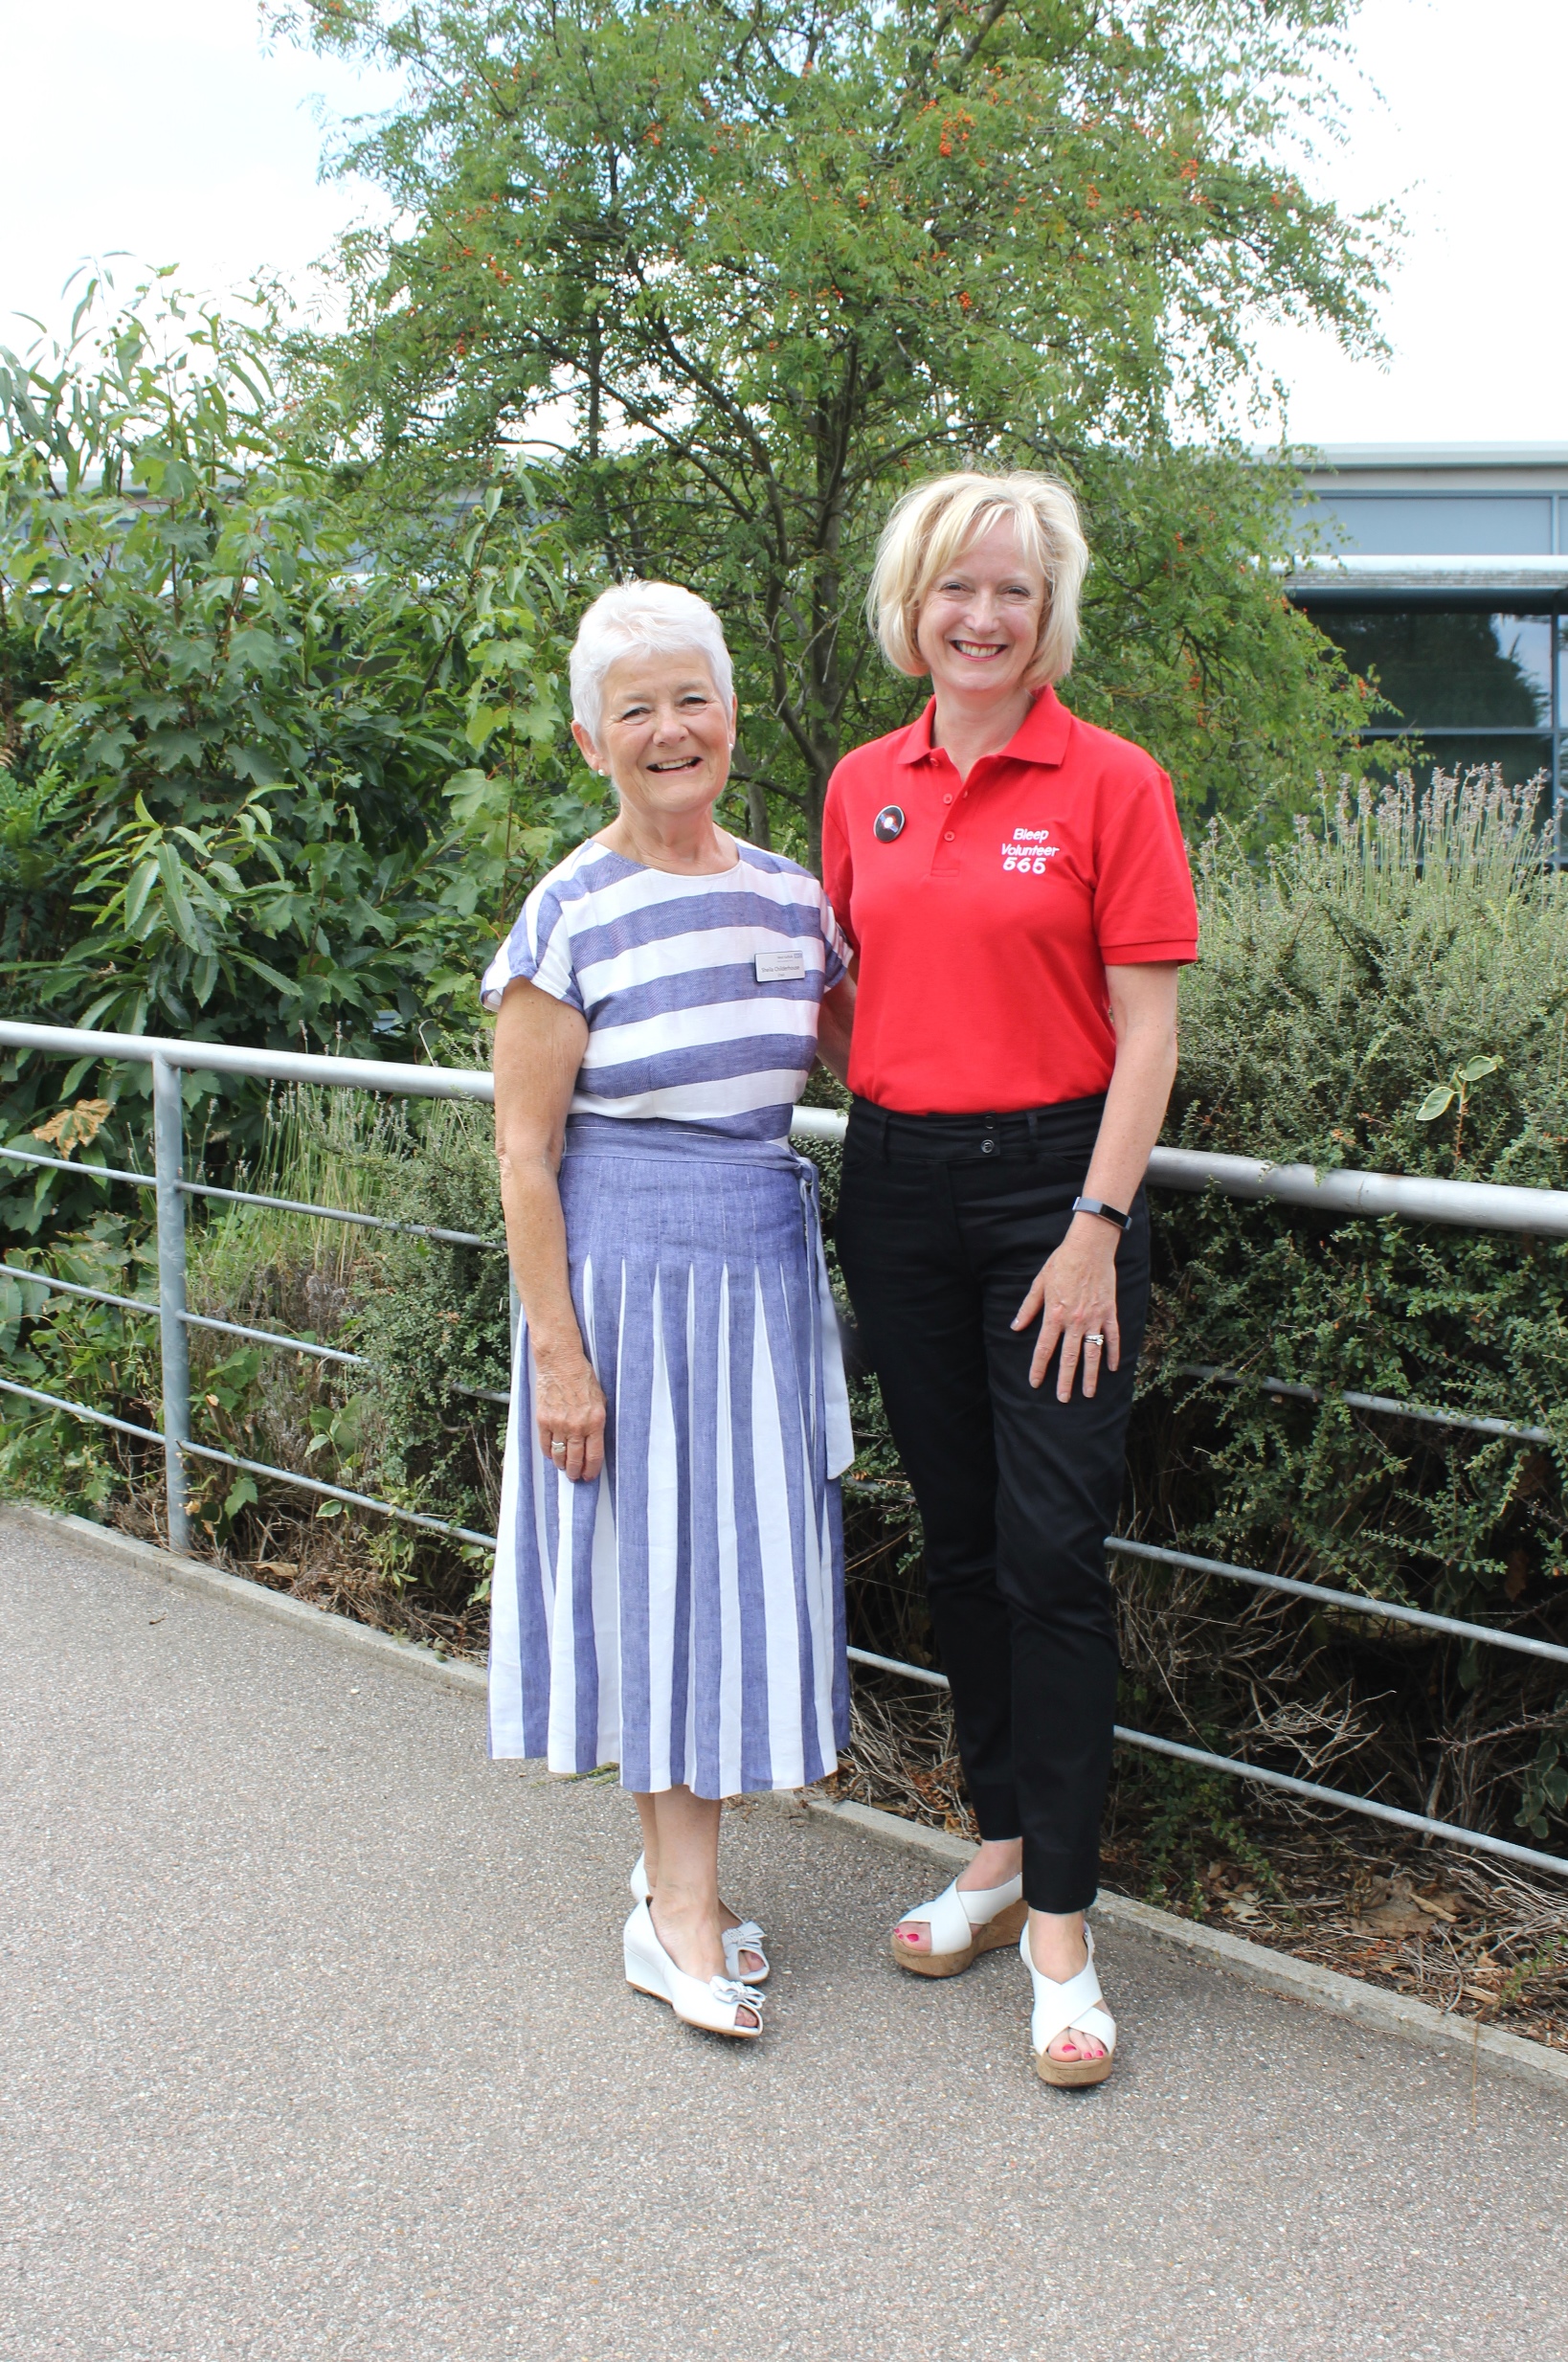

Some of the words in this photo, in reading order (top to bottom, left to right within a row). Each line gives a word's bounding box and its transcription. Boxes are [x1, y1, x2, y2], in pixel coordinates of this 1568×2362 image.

[1013, 828, 1049, 844] Bleep
[1000, 844, 1061, 857] Volunteer
[1002, 857, 1047, 875] 565
